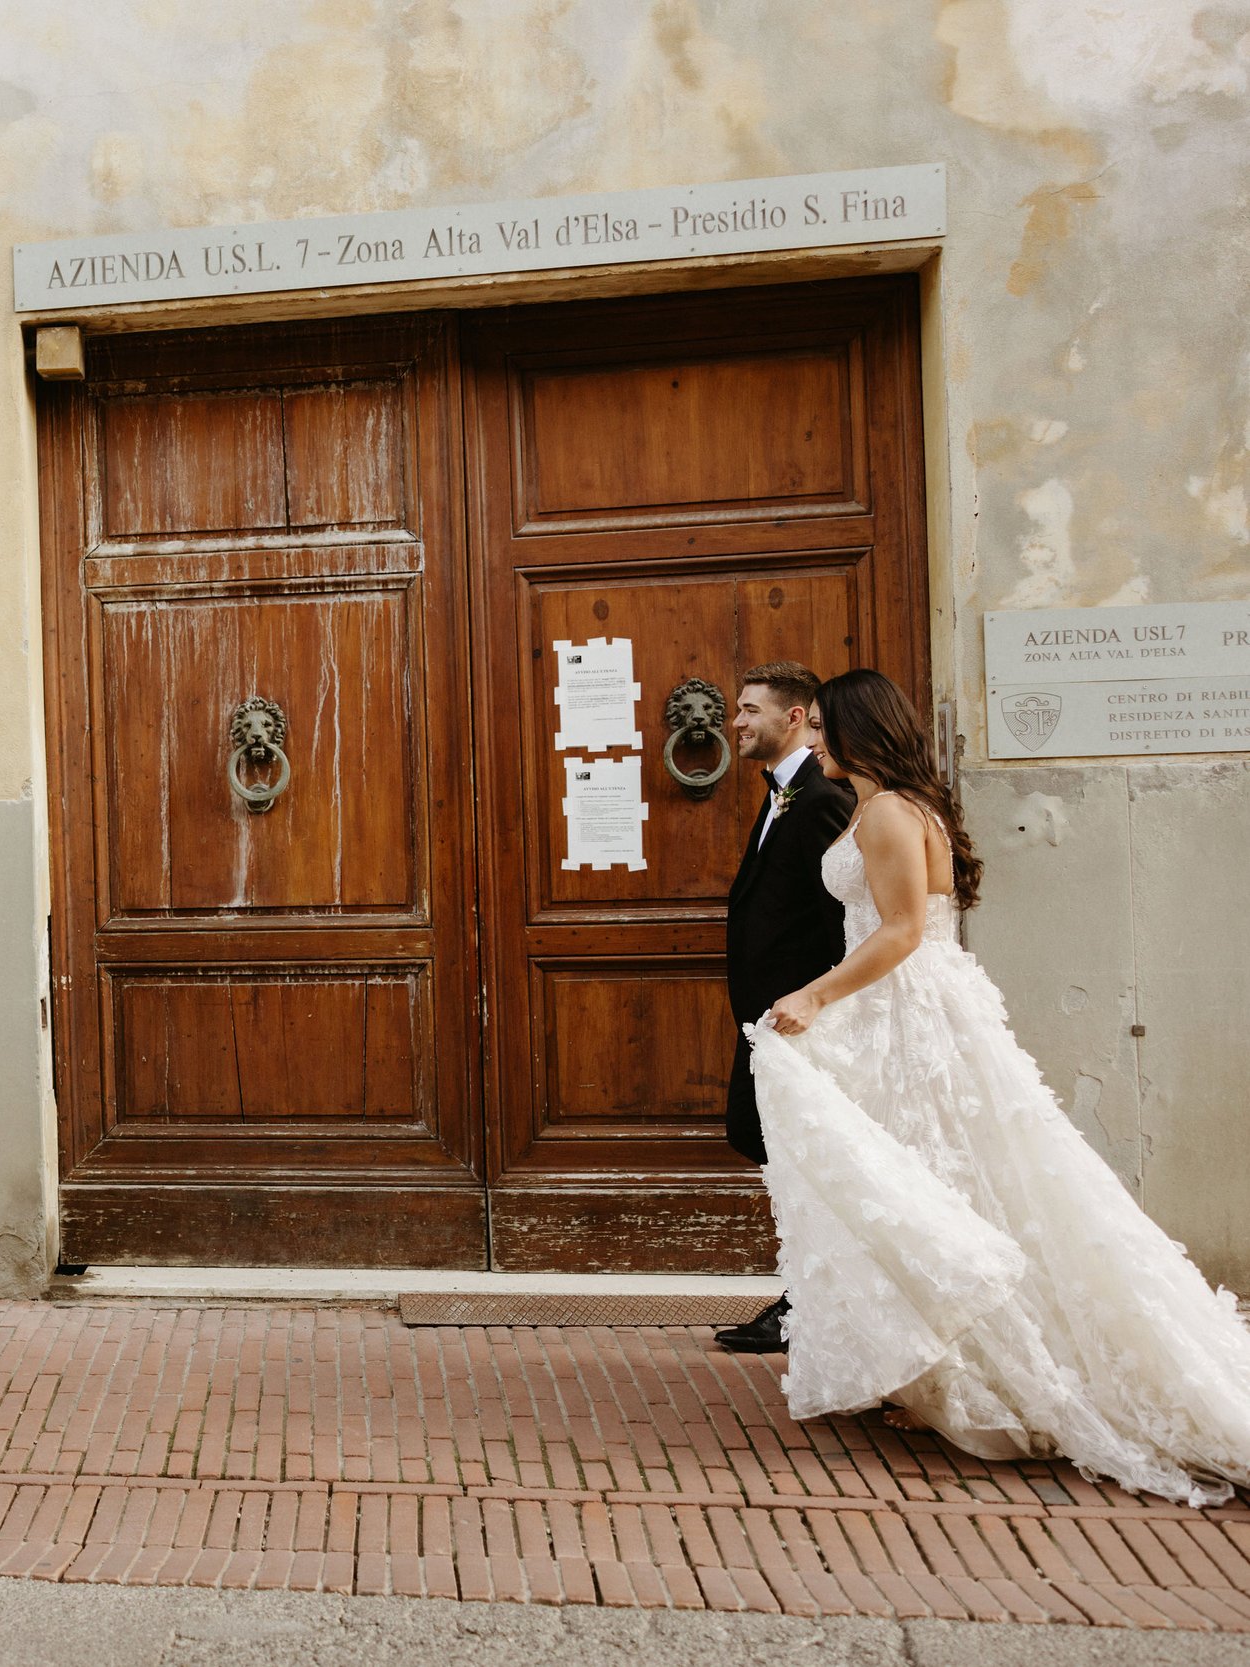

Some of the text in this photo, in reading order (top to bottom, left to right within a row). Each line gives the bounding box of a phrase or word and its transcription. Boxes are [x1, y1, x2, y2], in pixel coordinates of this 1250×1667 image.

[47, 250, 185, 289] AZIENDA
[202, 242, 280, 276] U.S.L.
[422, 226, 481, 258] Alta
[496, 219, 540, 250] Val
[556, 213, 639, 246] d'Elsa
[671, 199, 786, 237] Presidio
[804, 195, 826, 225] S.
[841, 190, 907, 222] Fina
[1024, 629, 1121, 646] AZIENDA
[1222, 631, 1250, 646] PR
[1025, 648, 1185, 662] ZONA ALTA VAL D'ELSA
[1108, 693, 1167, 704] CENTRO
[1177, 693, 1191, 701] DI
[1109, 709, 1250, 722] RESIDENZA SANIT
[1110, 730, 1191, 742] DISTRETTO
[1200, 728, 1214, 737] DI
